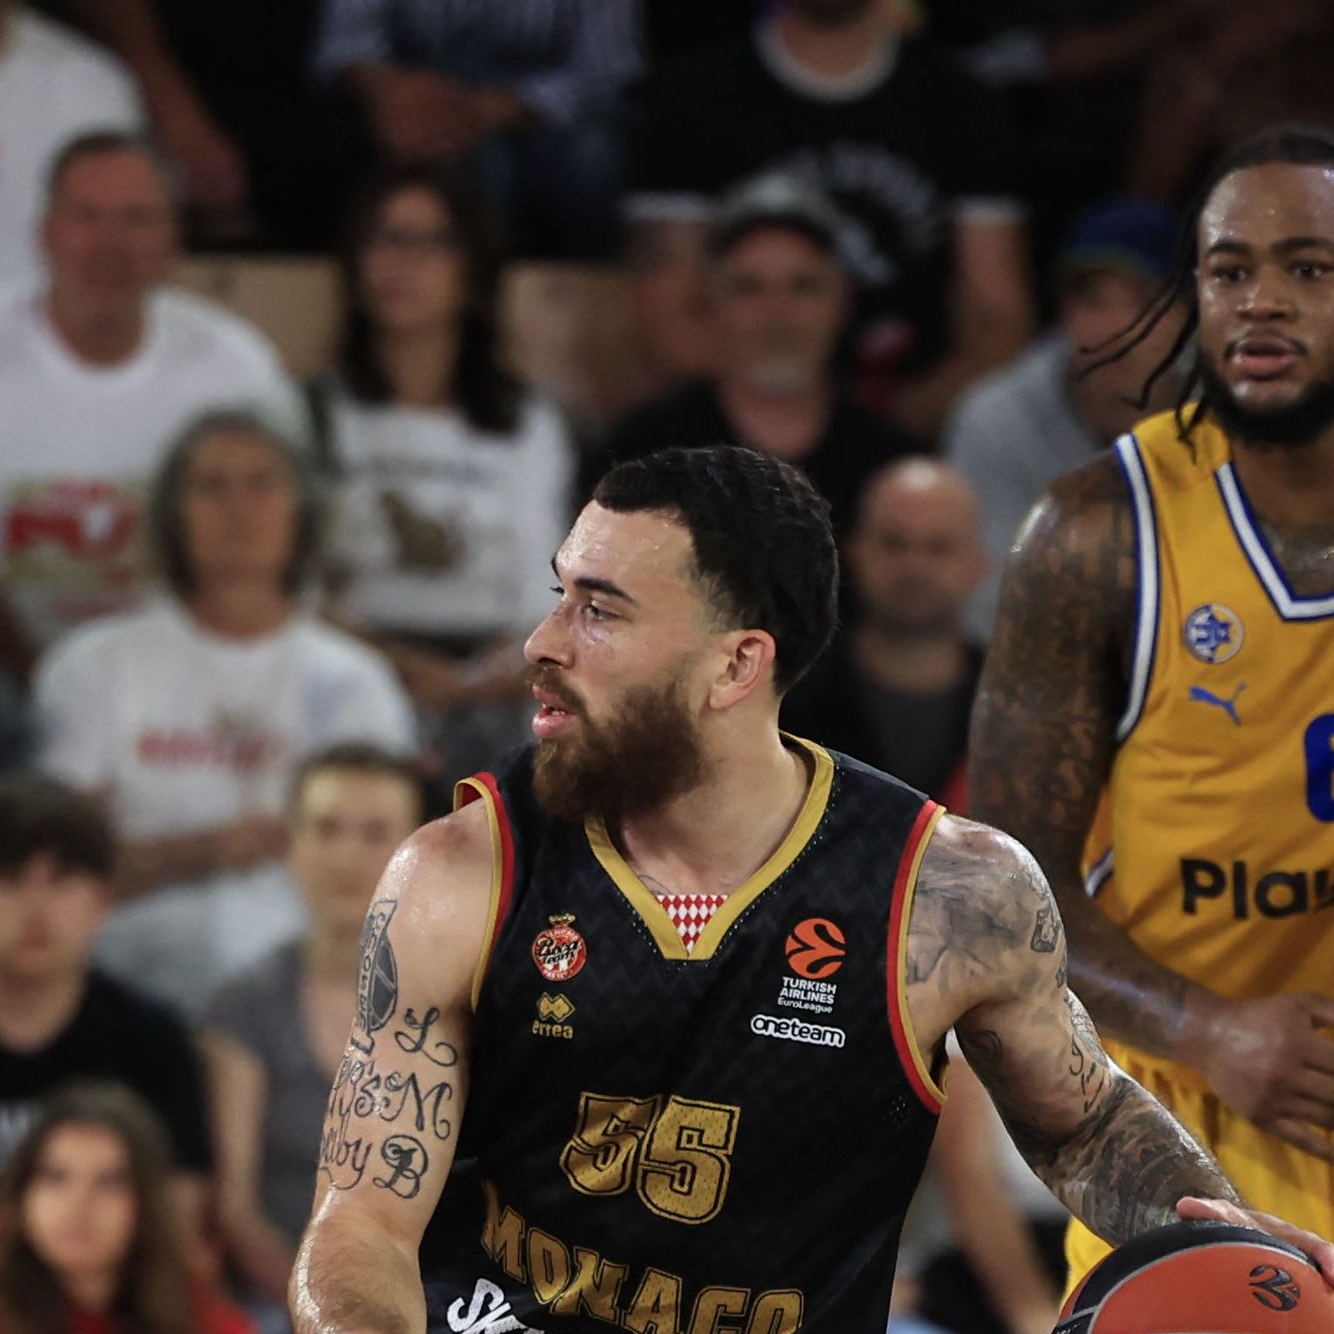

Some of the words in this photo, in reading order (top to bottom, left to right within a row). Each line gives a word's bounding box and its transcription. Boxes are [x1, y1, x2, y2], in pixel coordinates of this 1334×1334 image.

[782, 976, 837, 995] TURKISH
[777, 997, 833, 1014] EuroLeague
[779, 987, 835, 1005] AIRLINES
[752, 1016, 845, 1047] oneteam
[560, 1092, 741, 1225] 55
